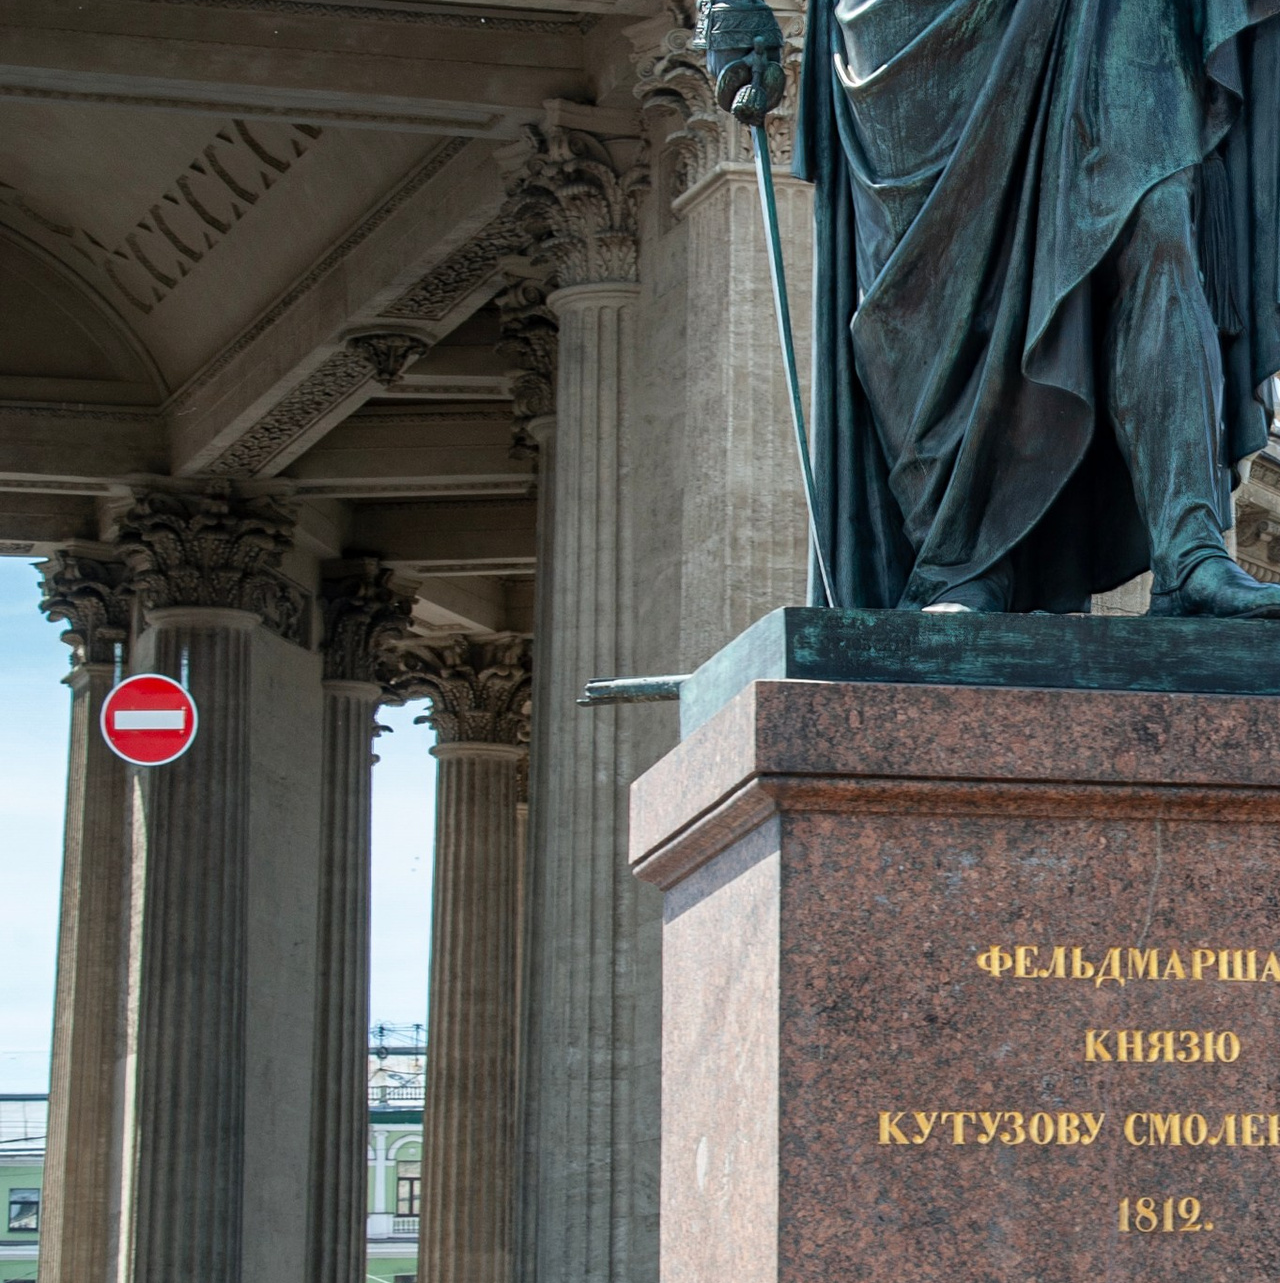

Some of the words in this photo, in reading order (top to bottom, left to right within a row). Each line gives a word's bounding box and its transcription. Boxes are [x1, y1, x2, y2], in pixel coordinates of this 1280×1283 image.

[1085, 1028, 1242, 1064] КНЯЗЮ
[878, 1111, 1105, 1147] КУТУЗОВУ
[1117, 1196, 1215, 1233] 1812.
